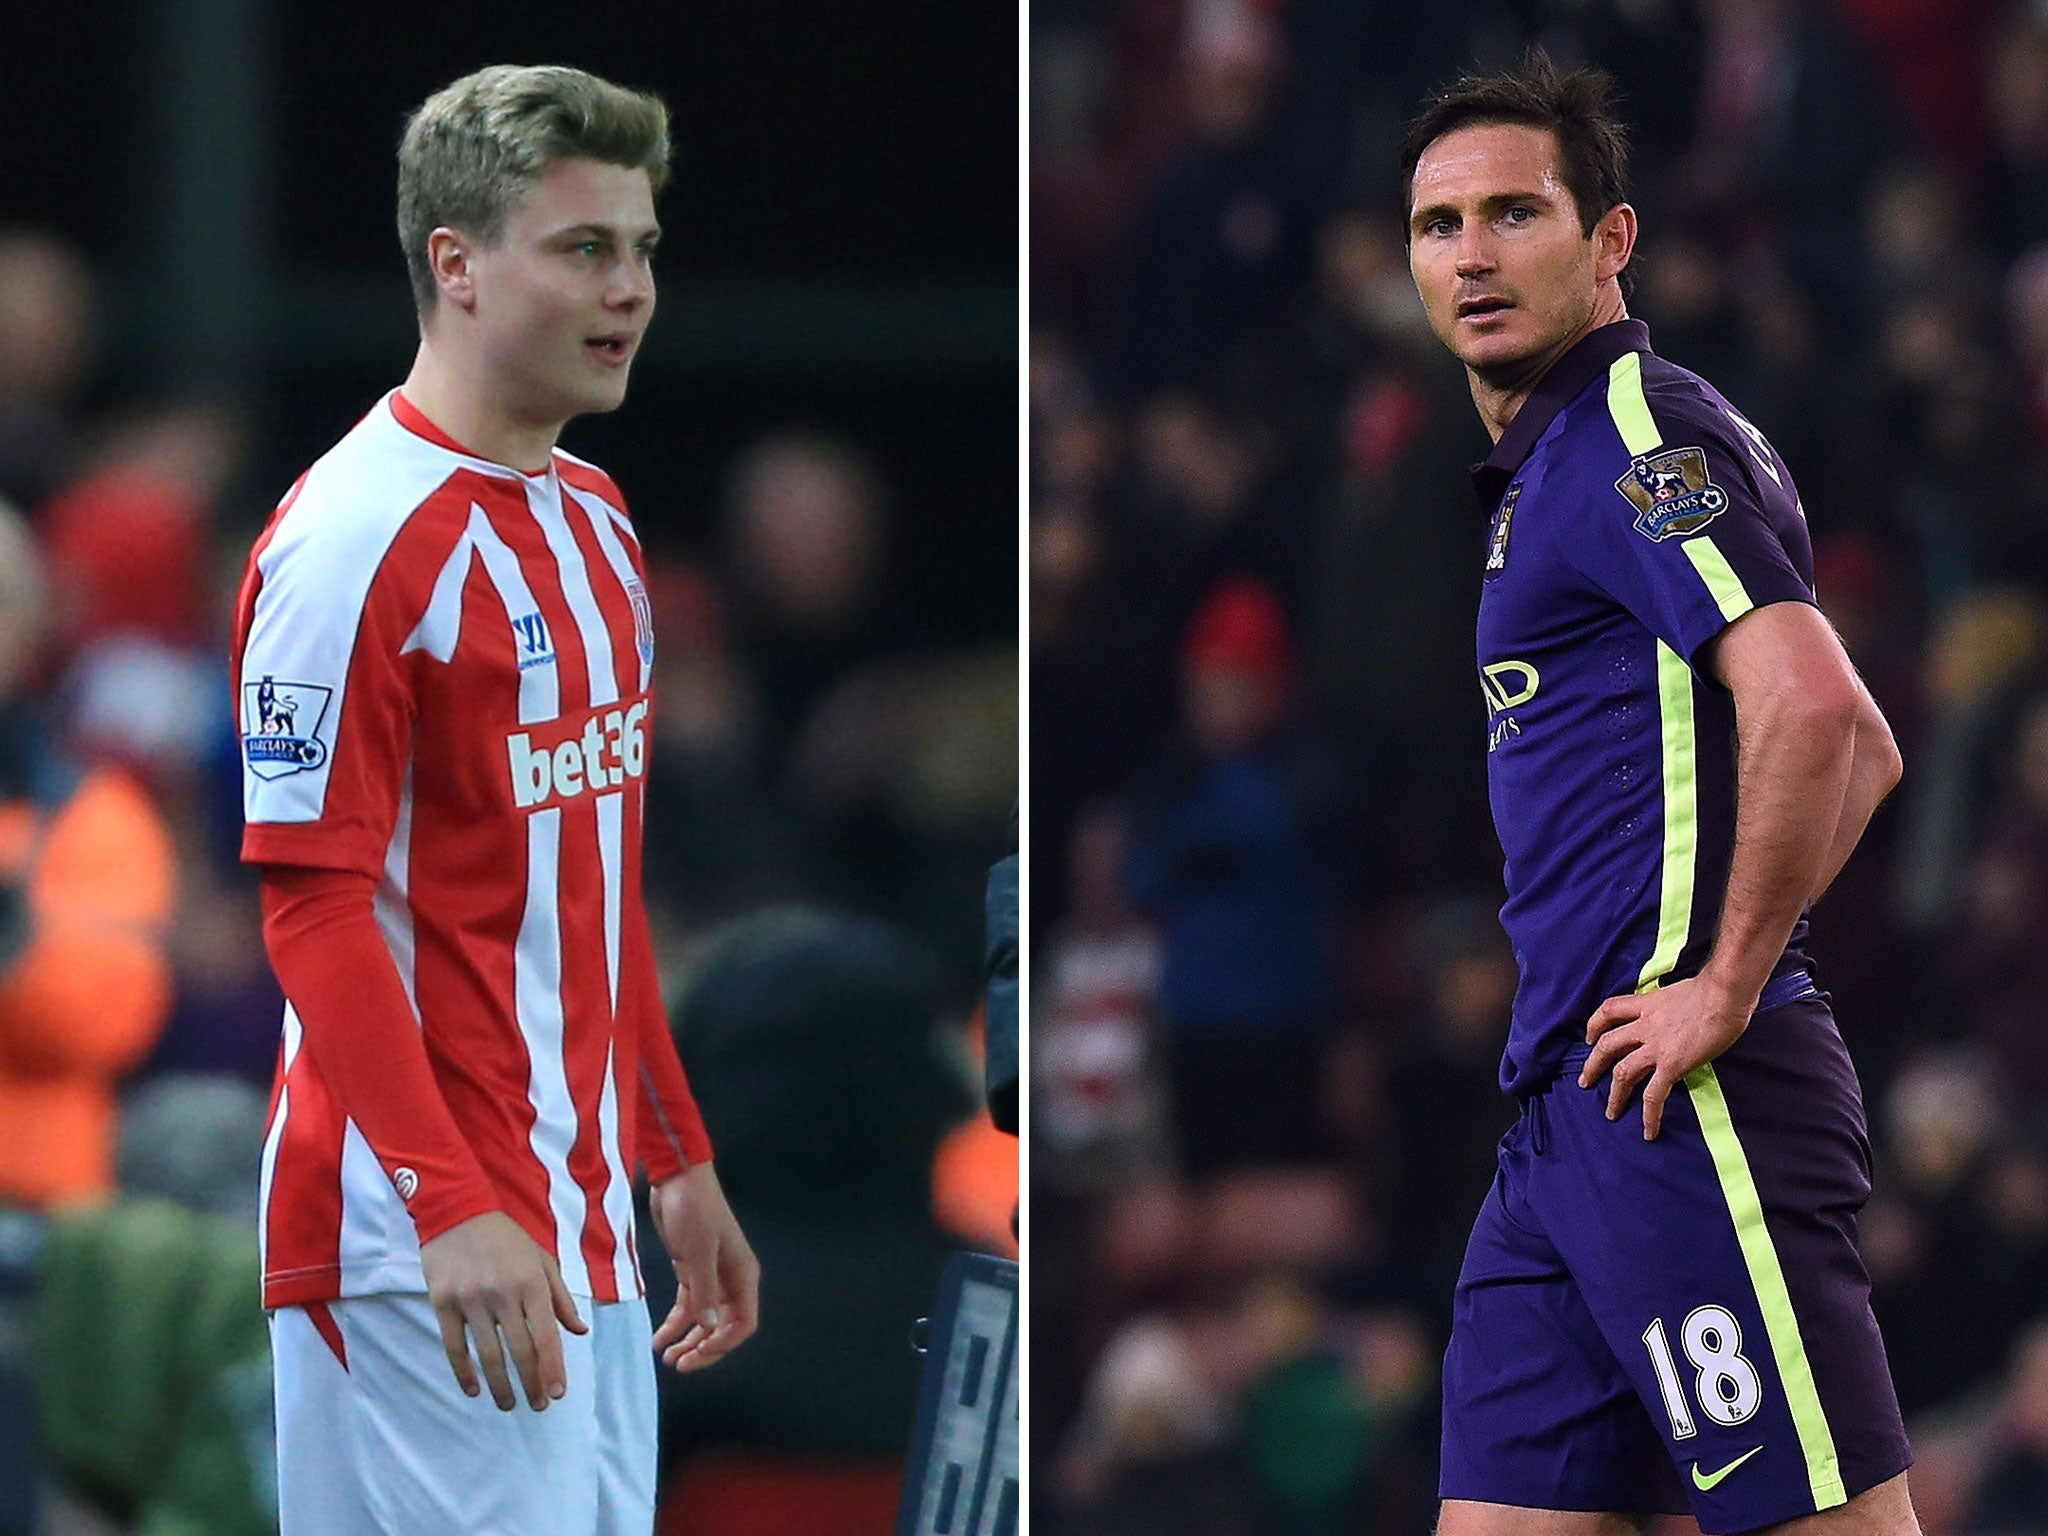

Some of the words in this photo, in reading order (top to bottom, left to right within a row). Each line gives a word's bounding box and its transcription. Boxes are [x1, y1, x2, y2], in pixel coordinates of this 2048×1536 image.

[1647, 496, 1699, 527] BARCLAYS
[507, 698, 649, 808] bet36
[1642, 1304, 1762, 1440] 18
